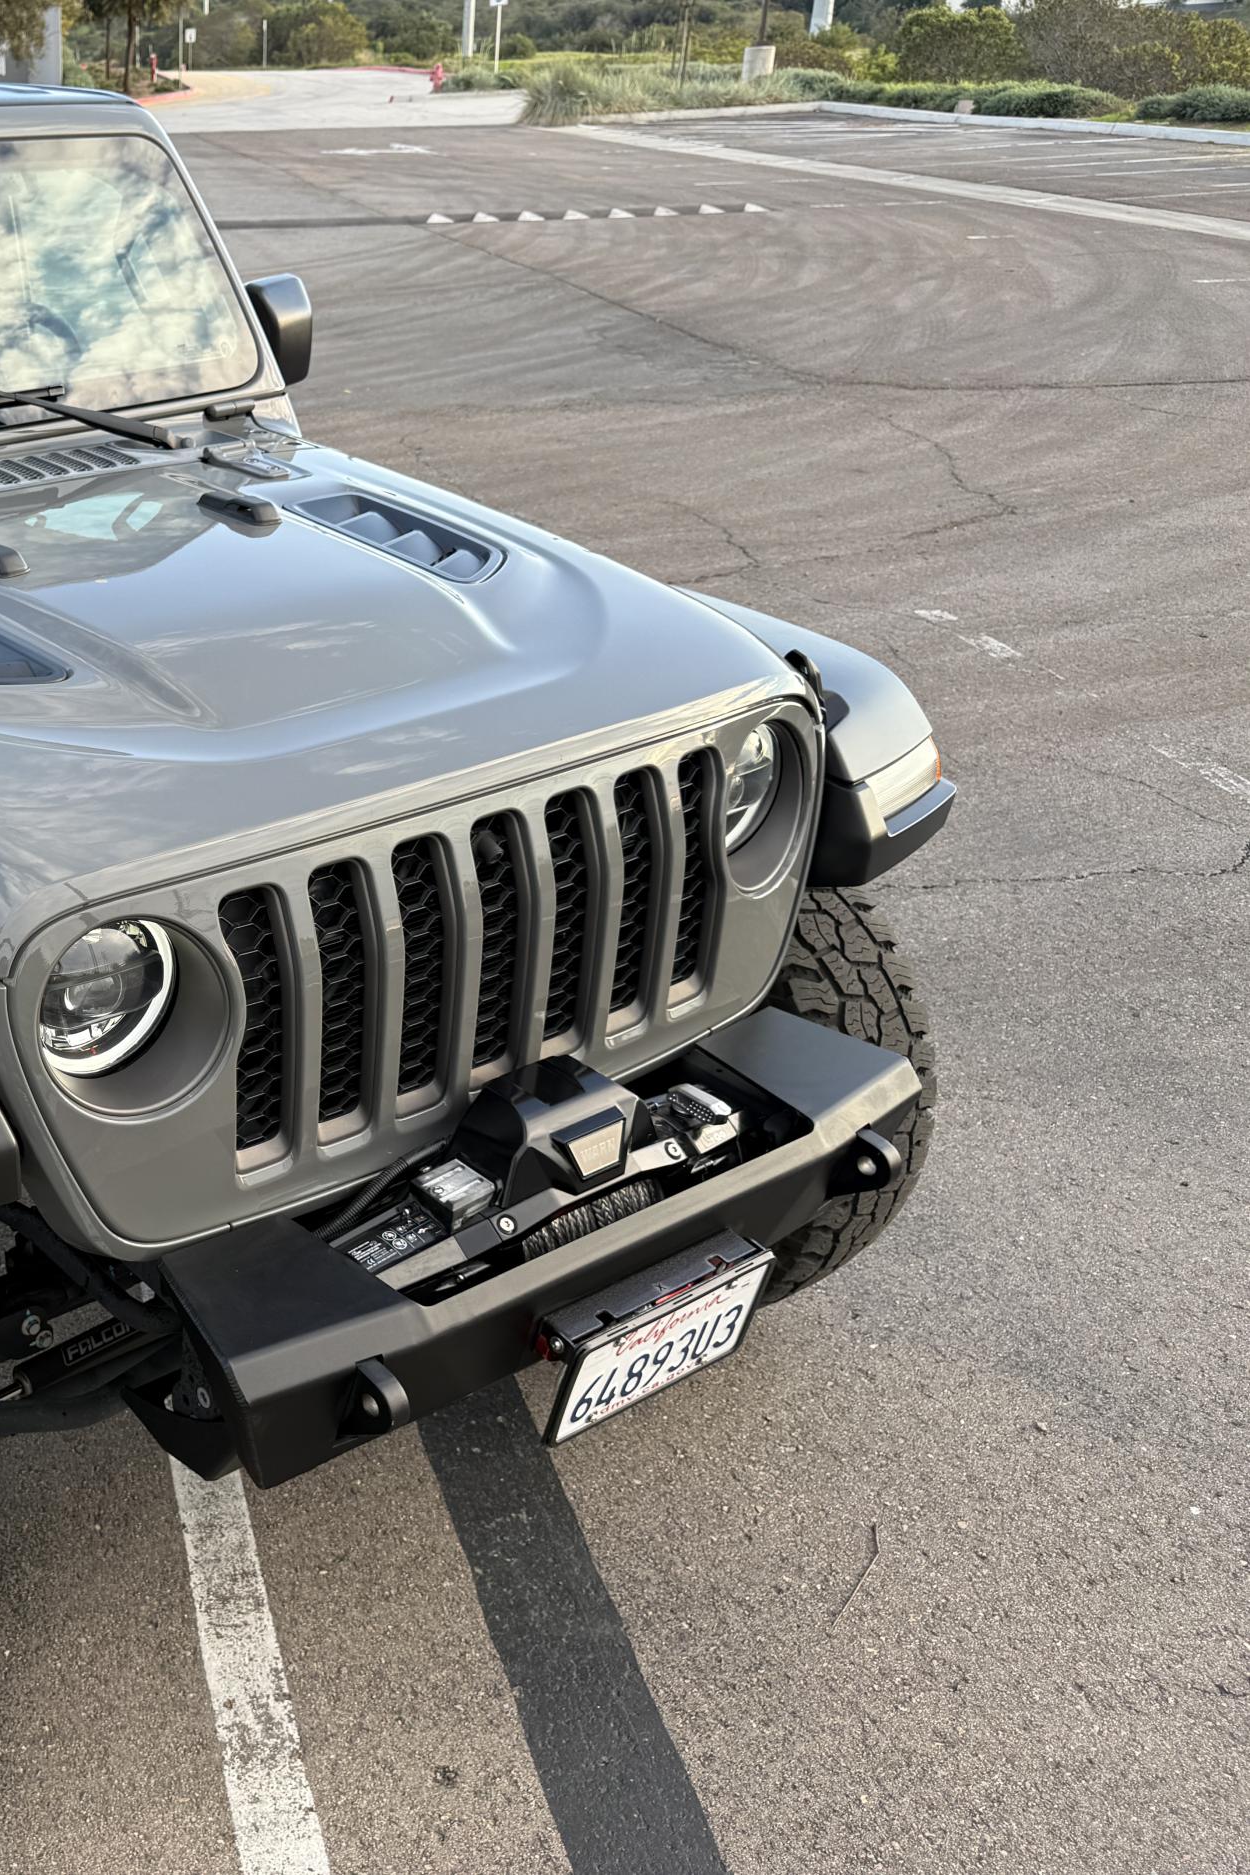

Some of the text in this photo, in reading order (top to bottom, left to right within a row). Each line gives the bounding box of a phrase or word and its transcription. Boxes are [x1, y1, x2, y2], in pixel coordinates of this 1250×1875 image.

[616, 1292, 731, 1357] California
[570, 1303, 744, 1423] 64893U3
[598, 1361, 699, 1415] dmv.ca.gov
